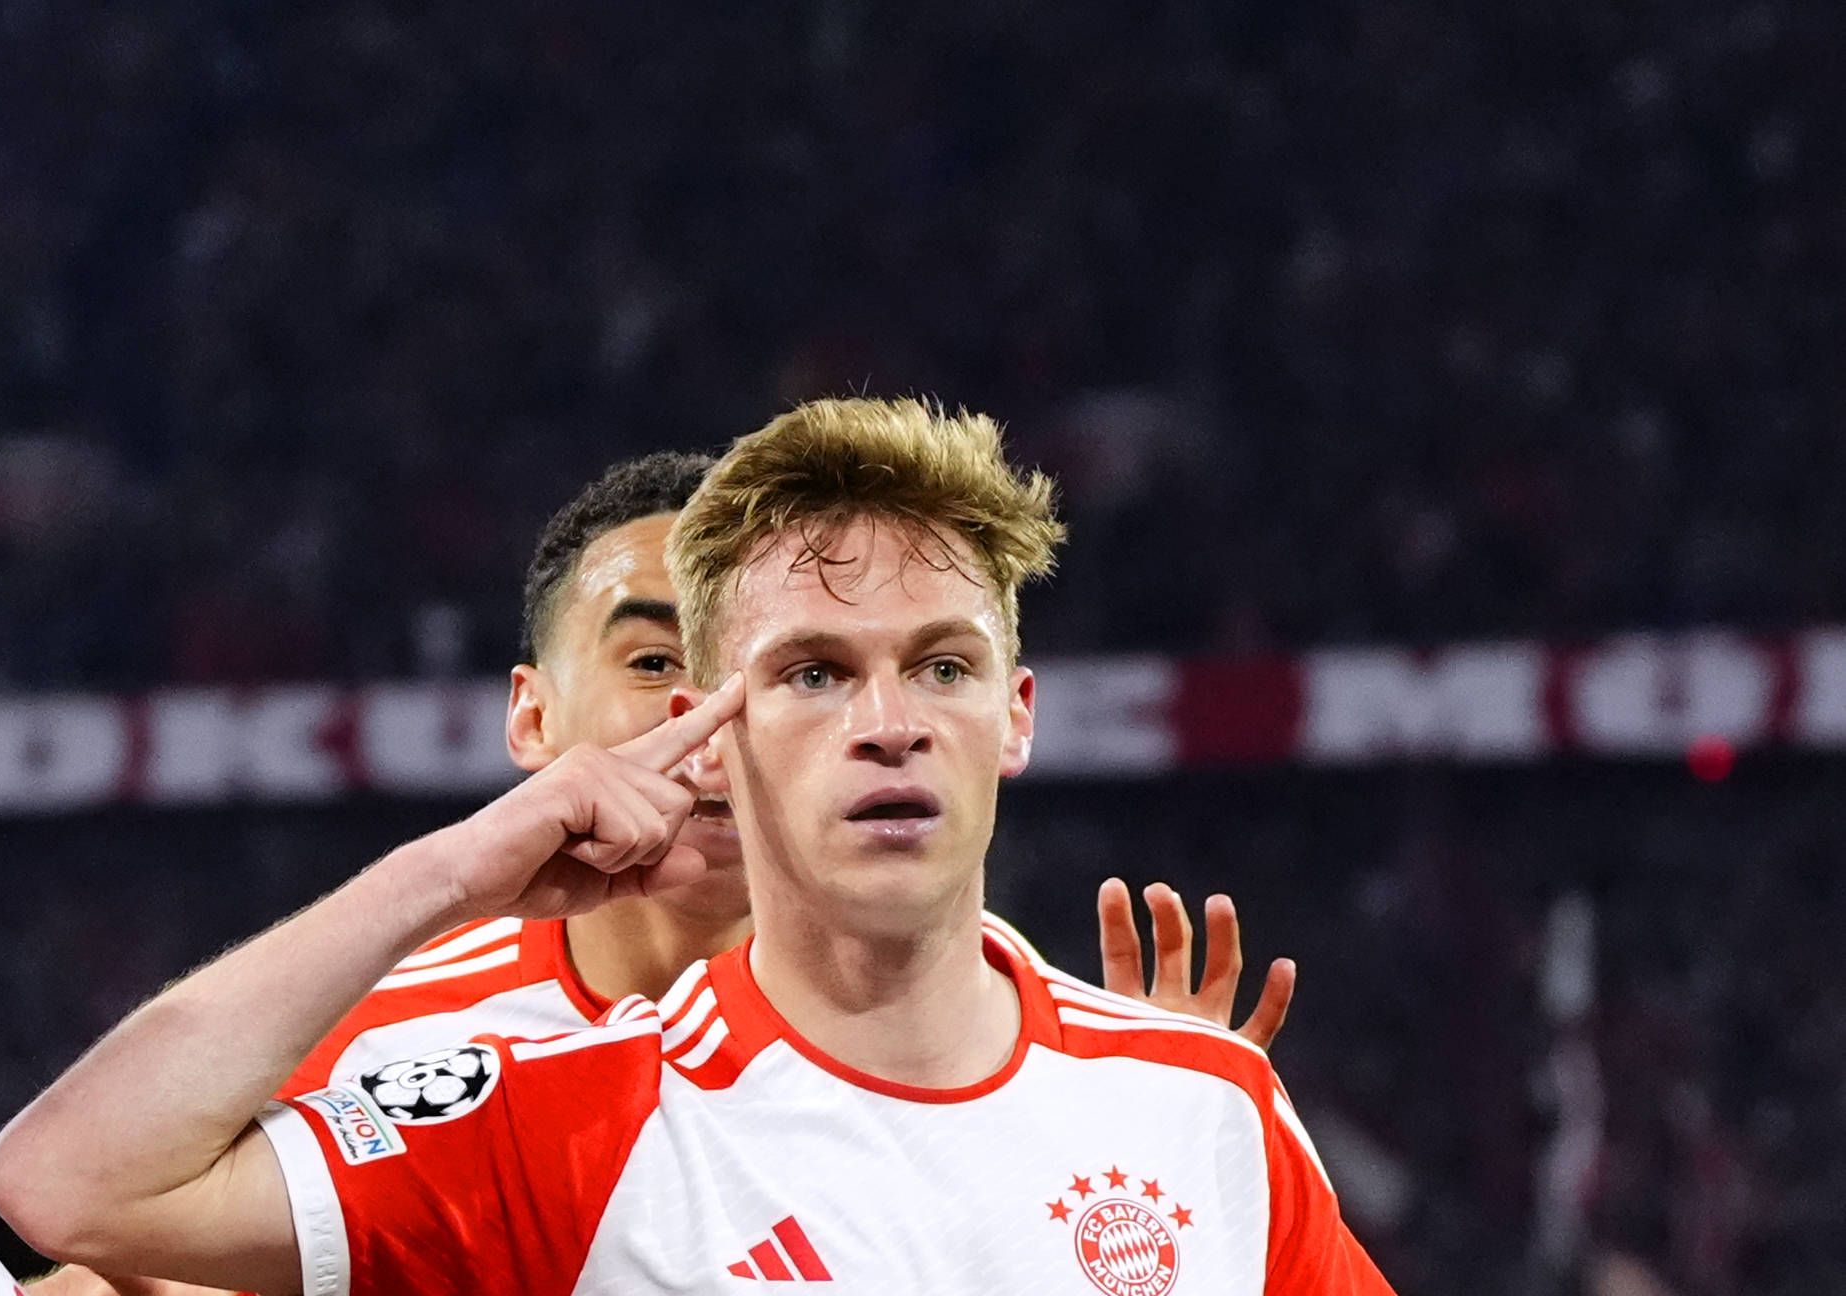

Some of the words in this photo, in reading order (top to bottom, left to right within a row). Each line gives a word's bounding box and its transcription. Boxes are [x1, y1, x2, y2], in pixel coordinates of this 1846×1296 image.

[397, 1058, 451, 1090] 6
[1083, 1217, 1103, 1243] FC
[1099, 1205, 1171, 1247] BAYERN
